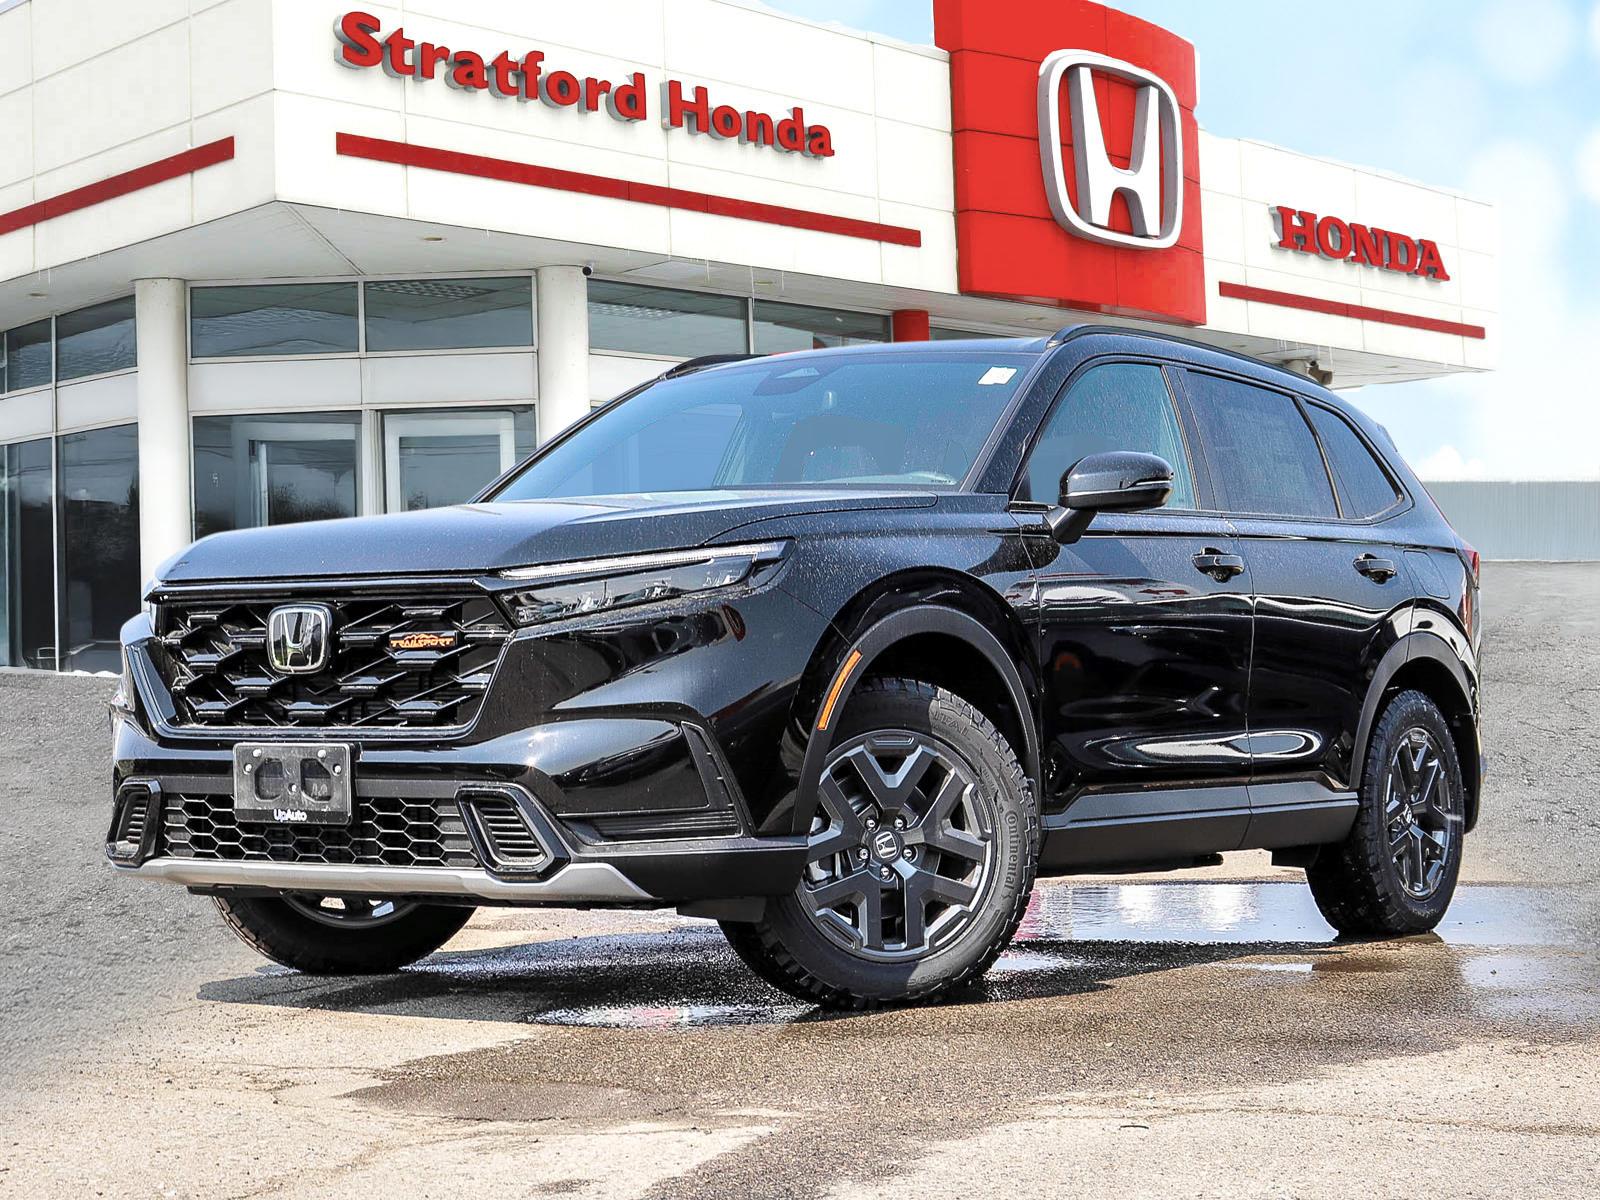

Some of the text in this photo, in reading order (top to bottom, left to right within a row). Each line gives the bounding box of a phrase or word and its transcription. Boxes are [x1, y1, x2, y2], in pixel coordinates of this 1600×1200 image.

[338, 11, 835, 157] Stratford Honda
[1271, 205, 1451, 282] HONDA
[273, 808, 307, 822] UpAuto
[1004, 810, 1020, 890] Continental
